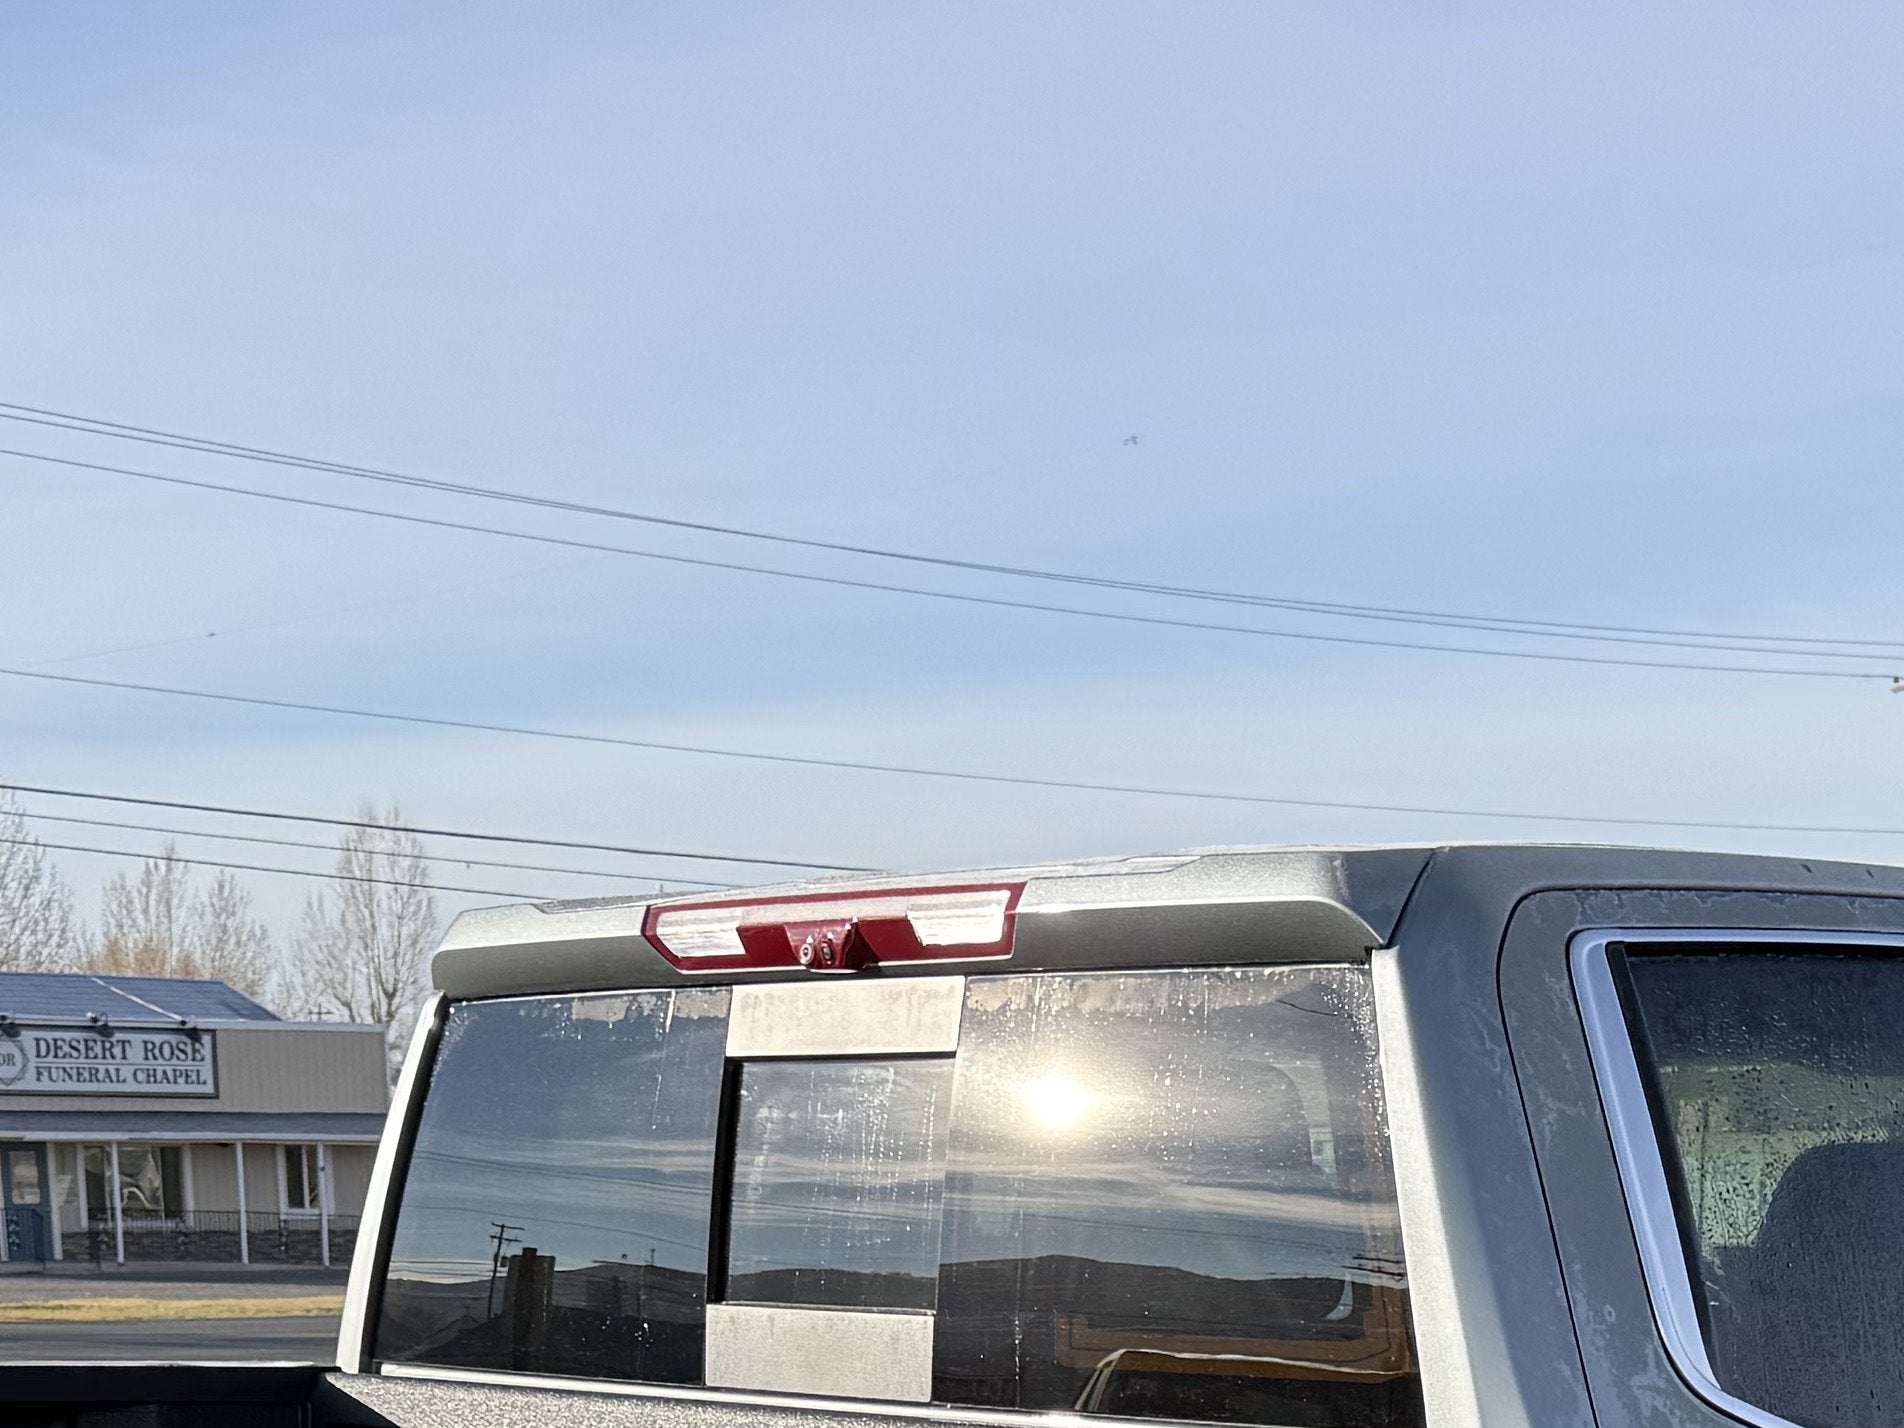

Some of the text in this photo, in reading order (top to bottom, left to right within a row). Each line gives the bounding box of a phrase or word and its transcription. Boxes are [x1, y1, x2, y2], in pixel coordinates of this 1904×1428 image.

[34, 1037, 205, 1062] DESERT ROSE
[35, 1066, 207, 1086] FUNERAL CHAPEL
